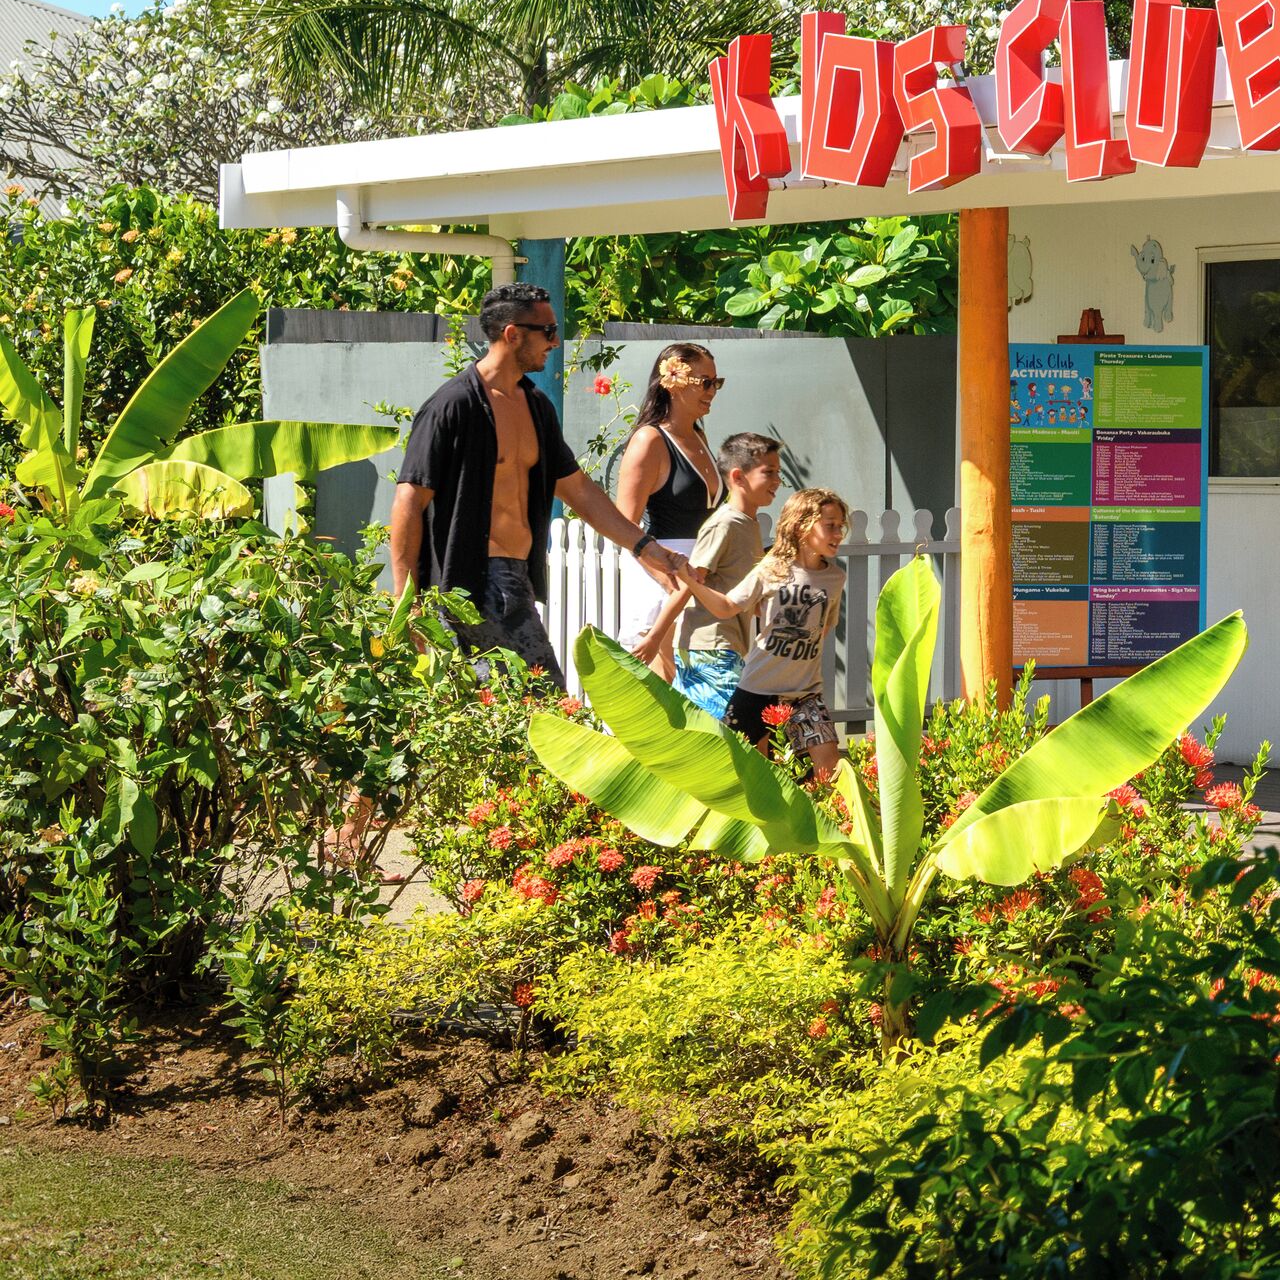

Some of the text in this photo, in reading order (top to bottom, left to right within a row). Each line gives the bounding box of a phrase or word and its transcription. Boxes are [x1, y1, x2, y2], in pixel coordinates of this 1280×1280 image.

[709, 12, 981, 221] KIDS
[1016, 352, 1074, 369] Kids Club
[1010, 368, 1079, 379] ACTIVITIES
[779, 584, 812, 606] DIG
[765, 634, 792, 657] DIG
